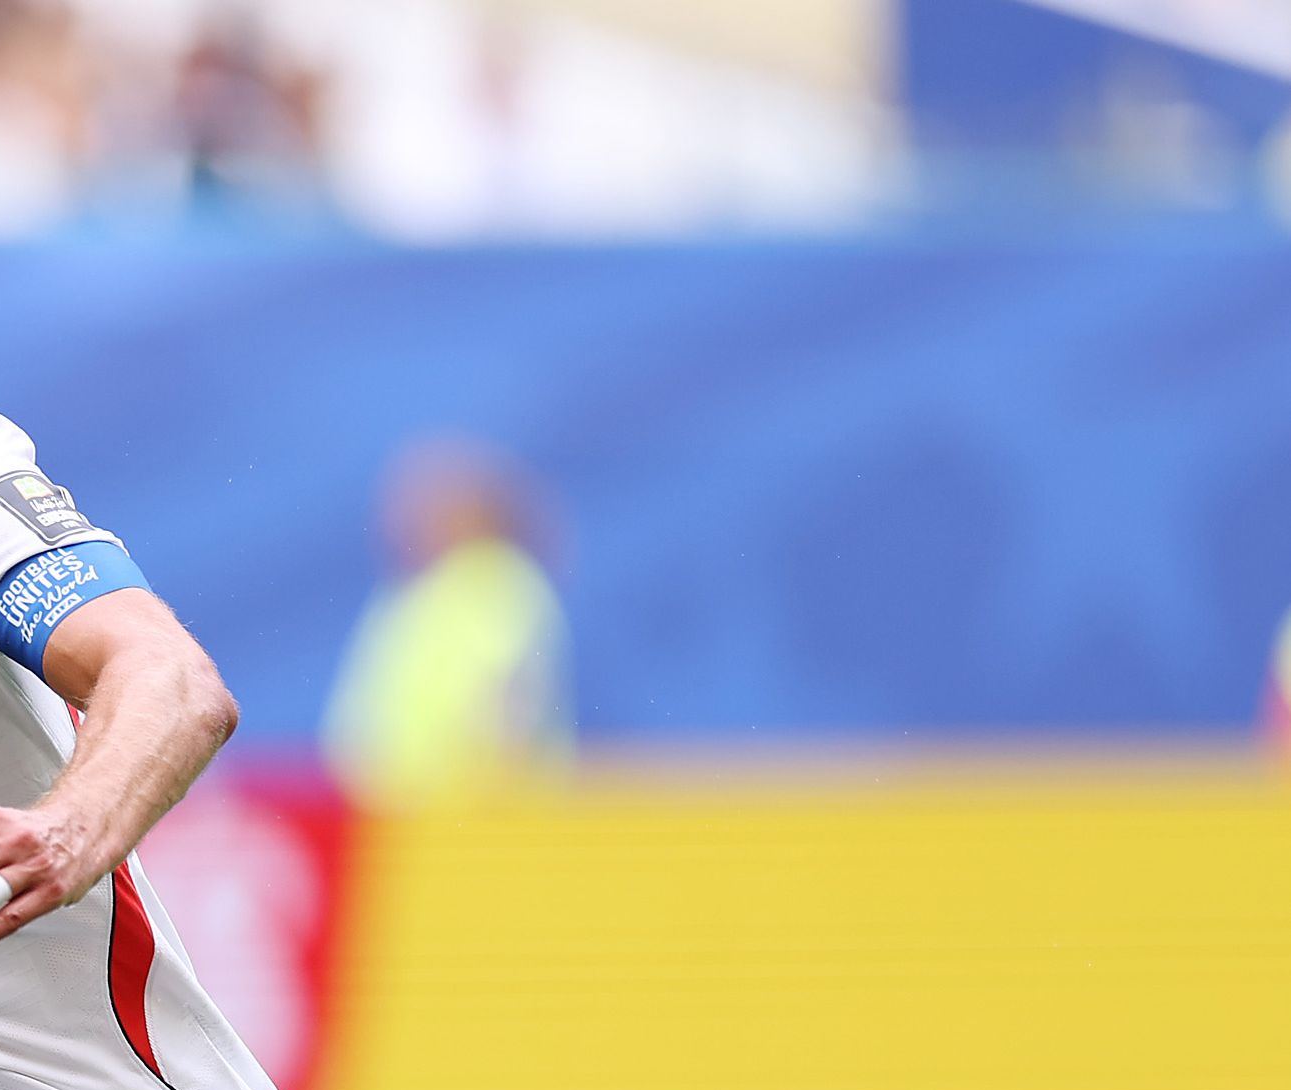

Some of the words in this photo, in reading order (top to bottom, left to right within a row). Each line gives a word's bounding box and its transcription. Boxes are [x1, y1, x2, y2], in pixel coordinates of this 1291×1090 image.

[6, 554, 84, 628] UNITES
[20, 611, 42, 644] the
[38, 565, 99, 610] World
